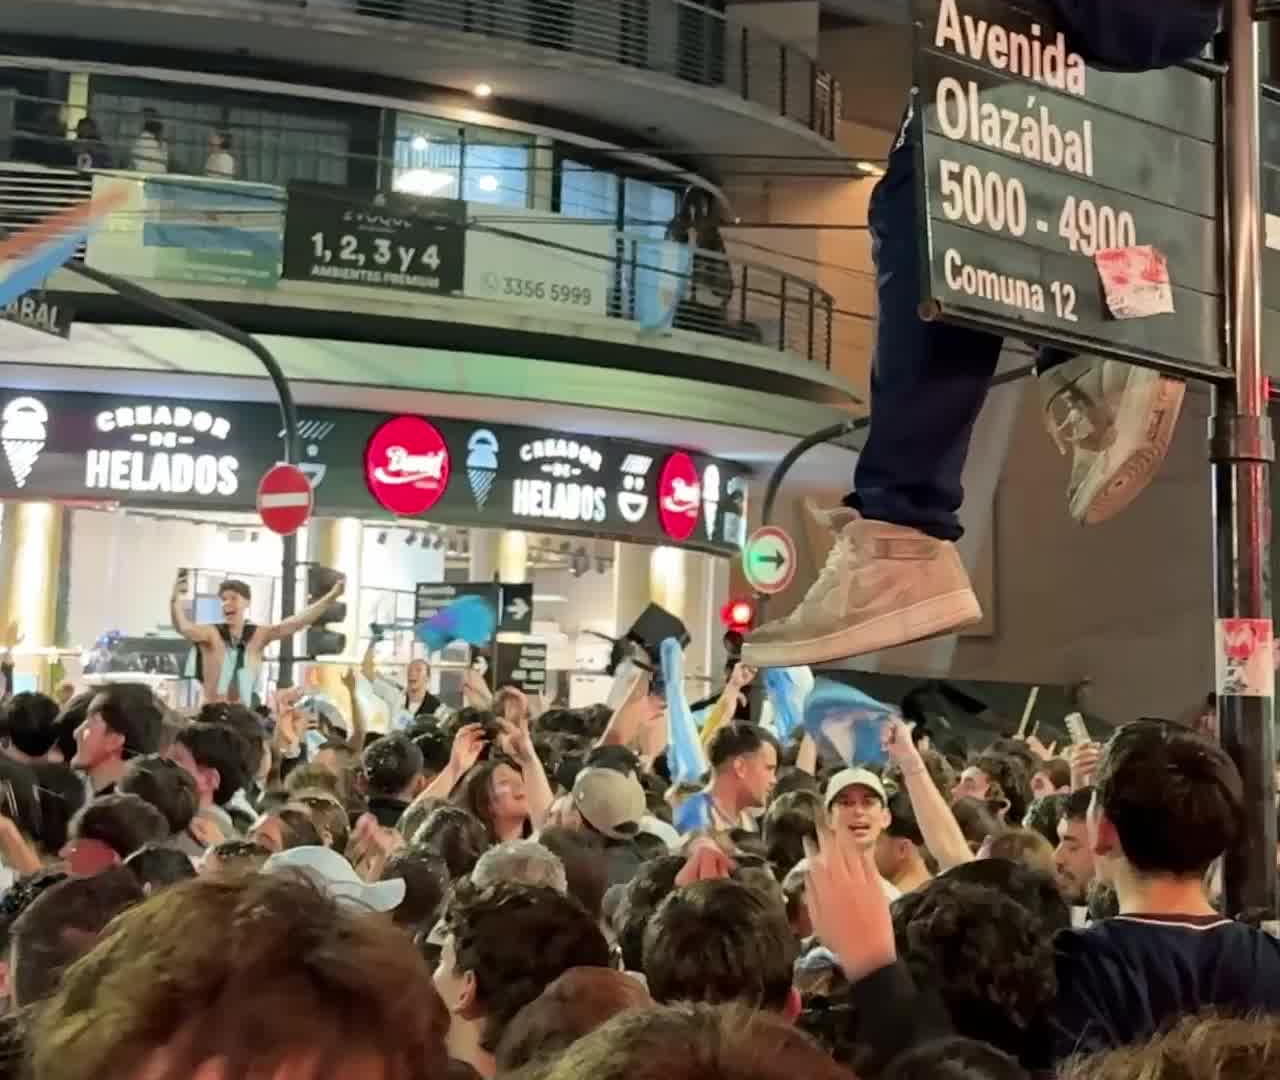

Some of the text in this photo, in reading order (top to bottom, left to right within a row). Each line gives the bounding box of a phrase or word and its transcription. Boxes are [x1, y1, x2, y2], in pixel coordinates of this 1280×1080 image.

[935, 76, 1094, 177] Olazábal
[938, 158, 1028, 238] 5000
[1058, 194, 1137, 258] 4900
[311, 231, 441, 272] 1, 2, 3 y 4
[503, 276, 593, 306] 3356 5999
[943, 247, 1045, 313] Comuna
[1050, 279, 1079, 322] 12
[95, 404, 232, 441] CREADOR
[84, 448, 240, 496] HELADOS
[519, 437, 602, 472] CREADOR
[511, 478, 607, 523] HELADOS
